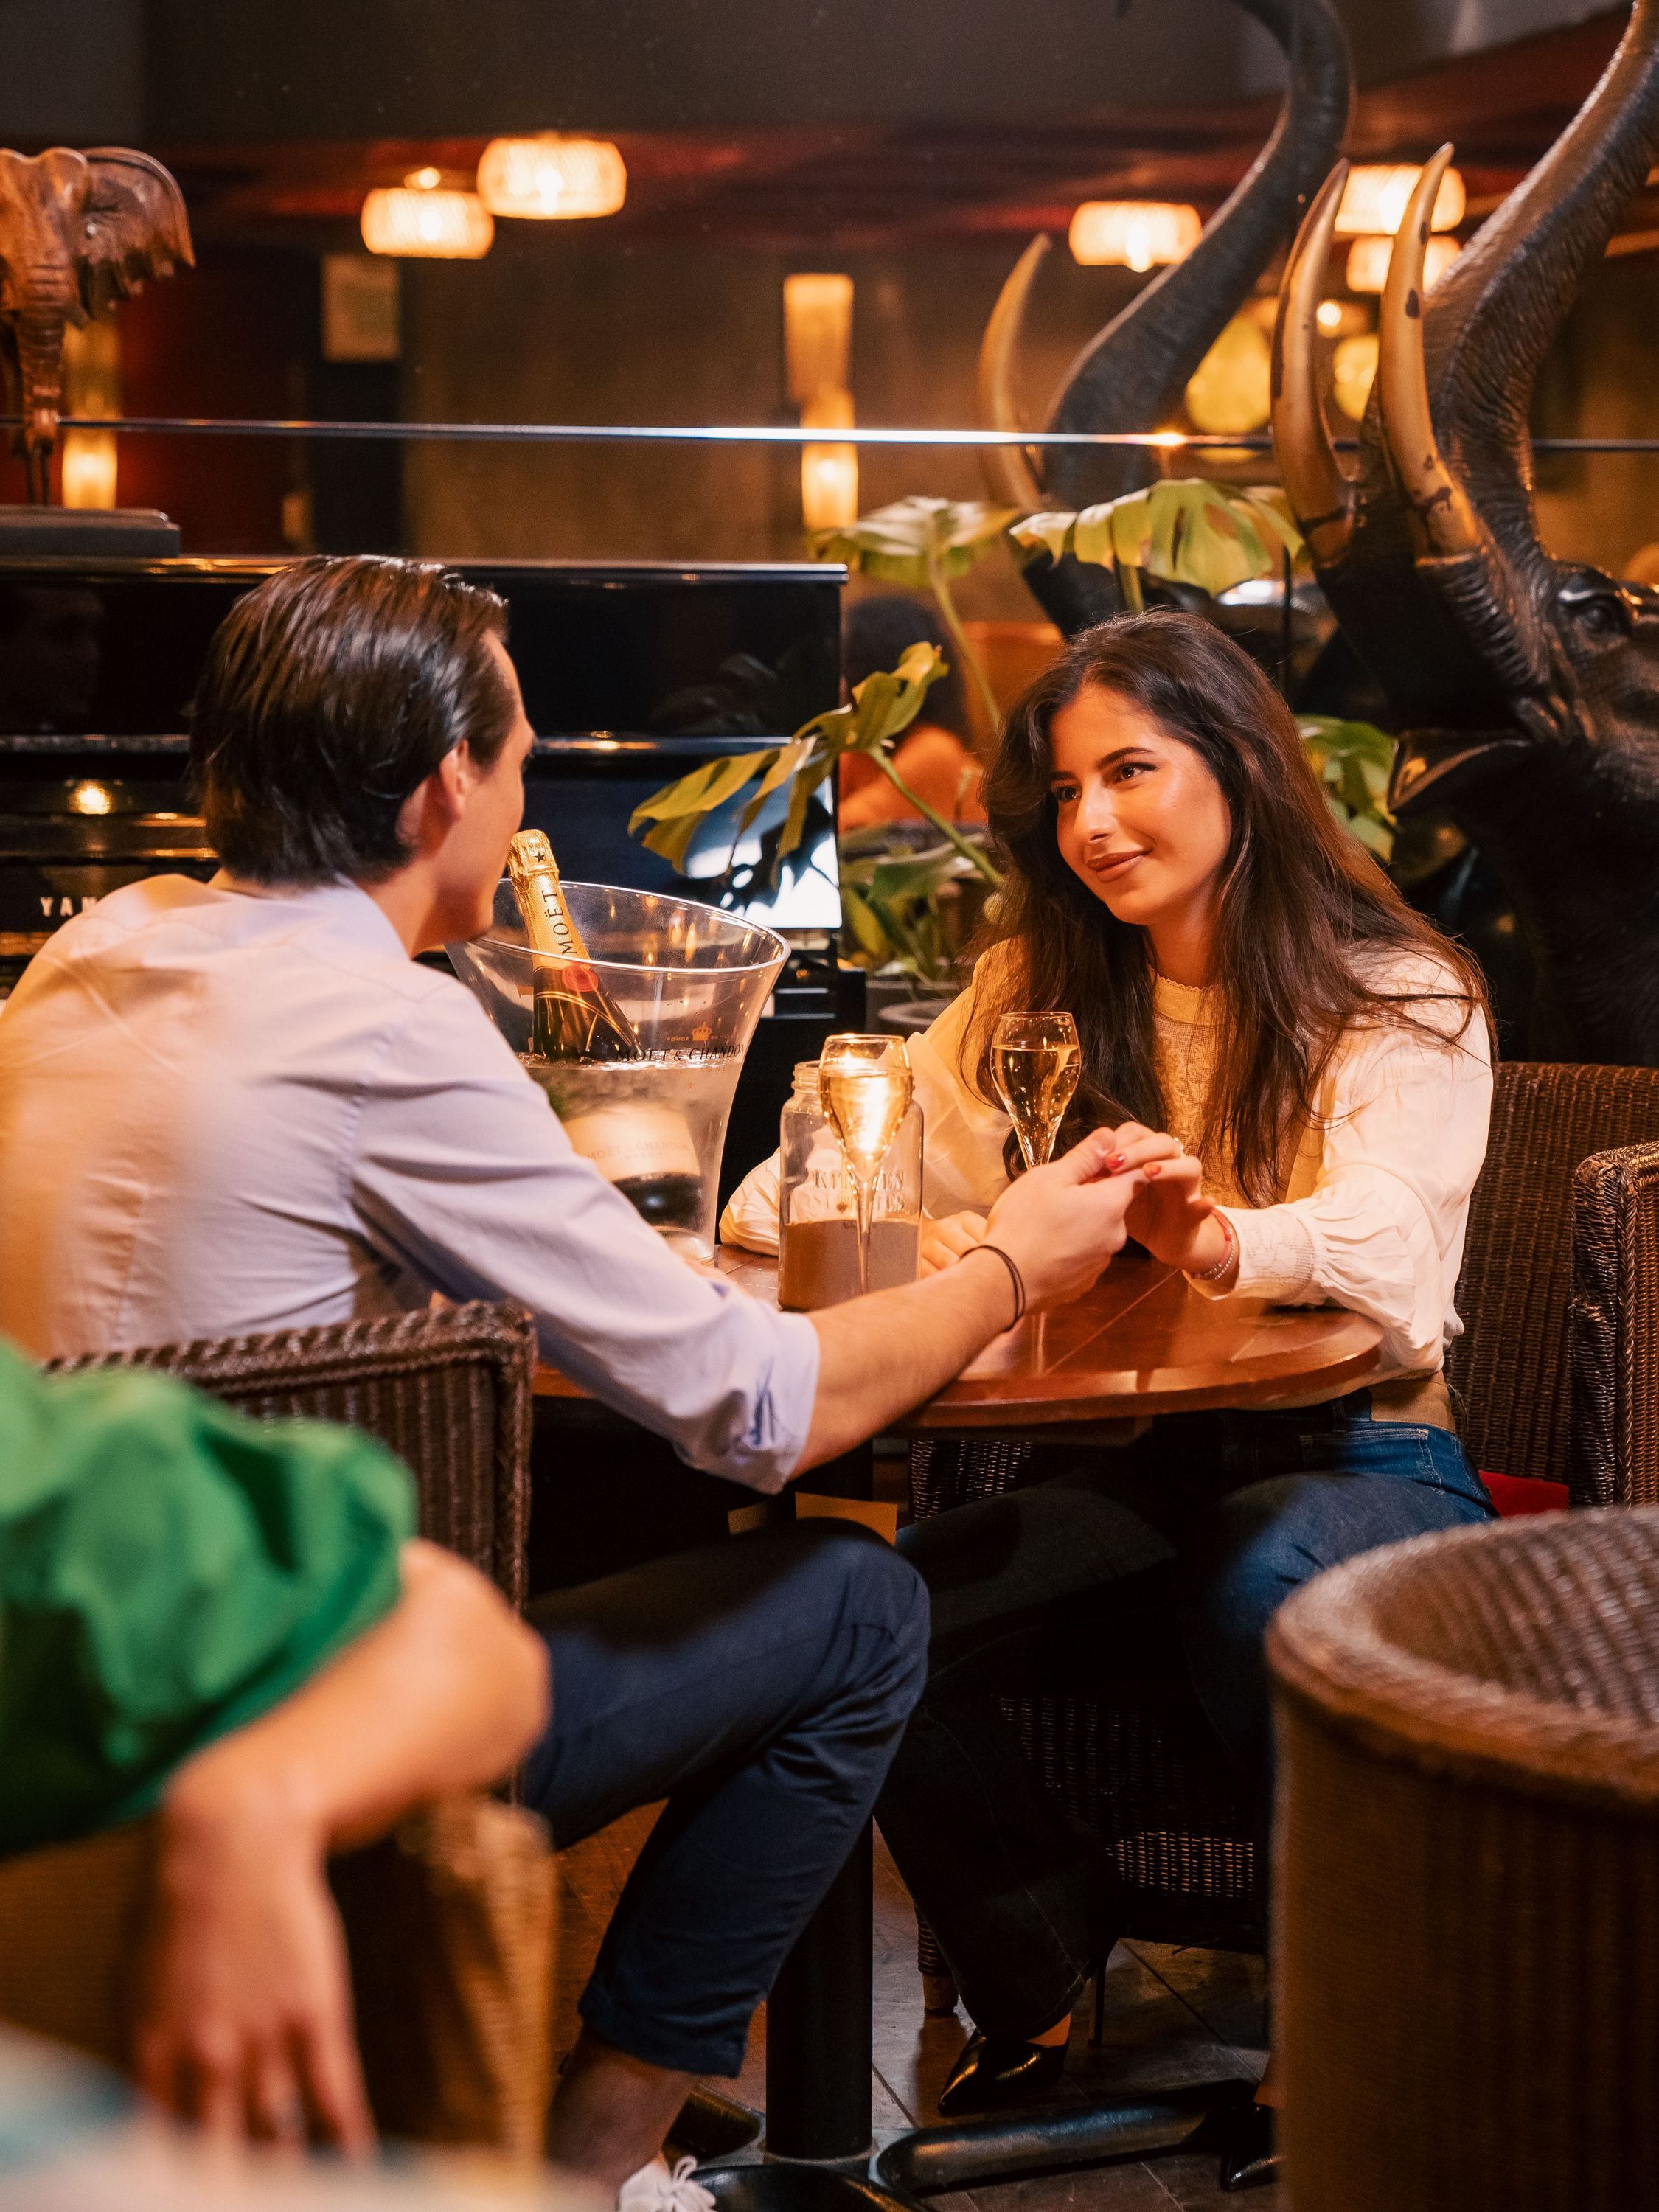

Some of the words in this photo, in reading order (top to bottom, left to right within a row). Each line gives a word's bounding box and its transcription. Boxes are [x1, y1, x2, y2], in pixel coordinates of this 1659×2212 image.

[542, 890, 577, 955] MOËT
[673, 1051, 683, 1061] &
[689, 1043, 745, 1061] CHANDON
